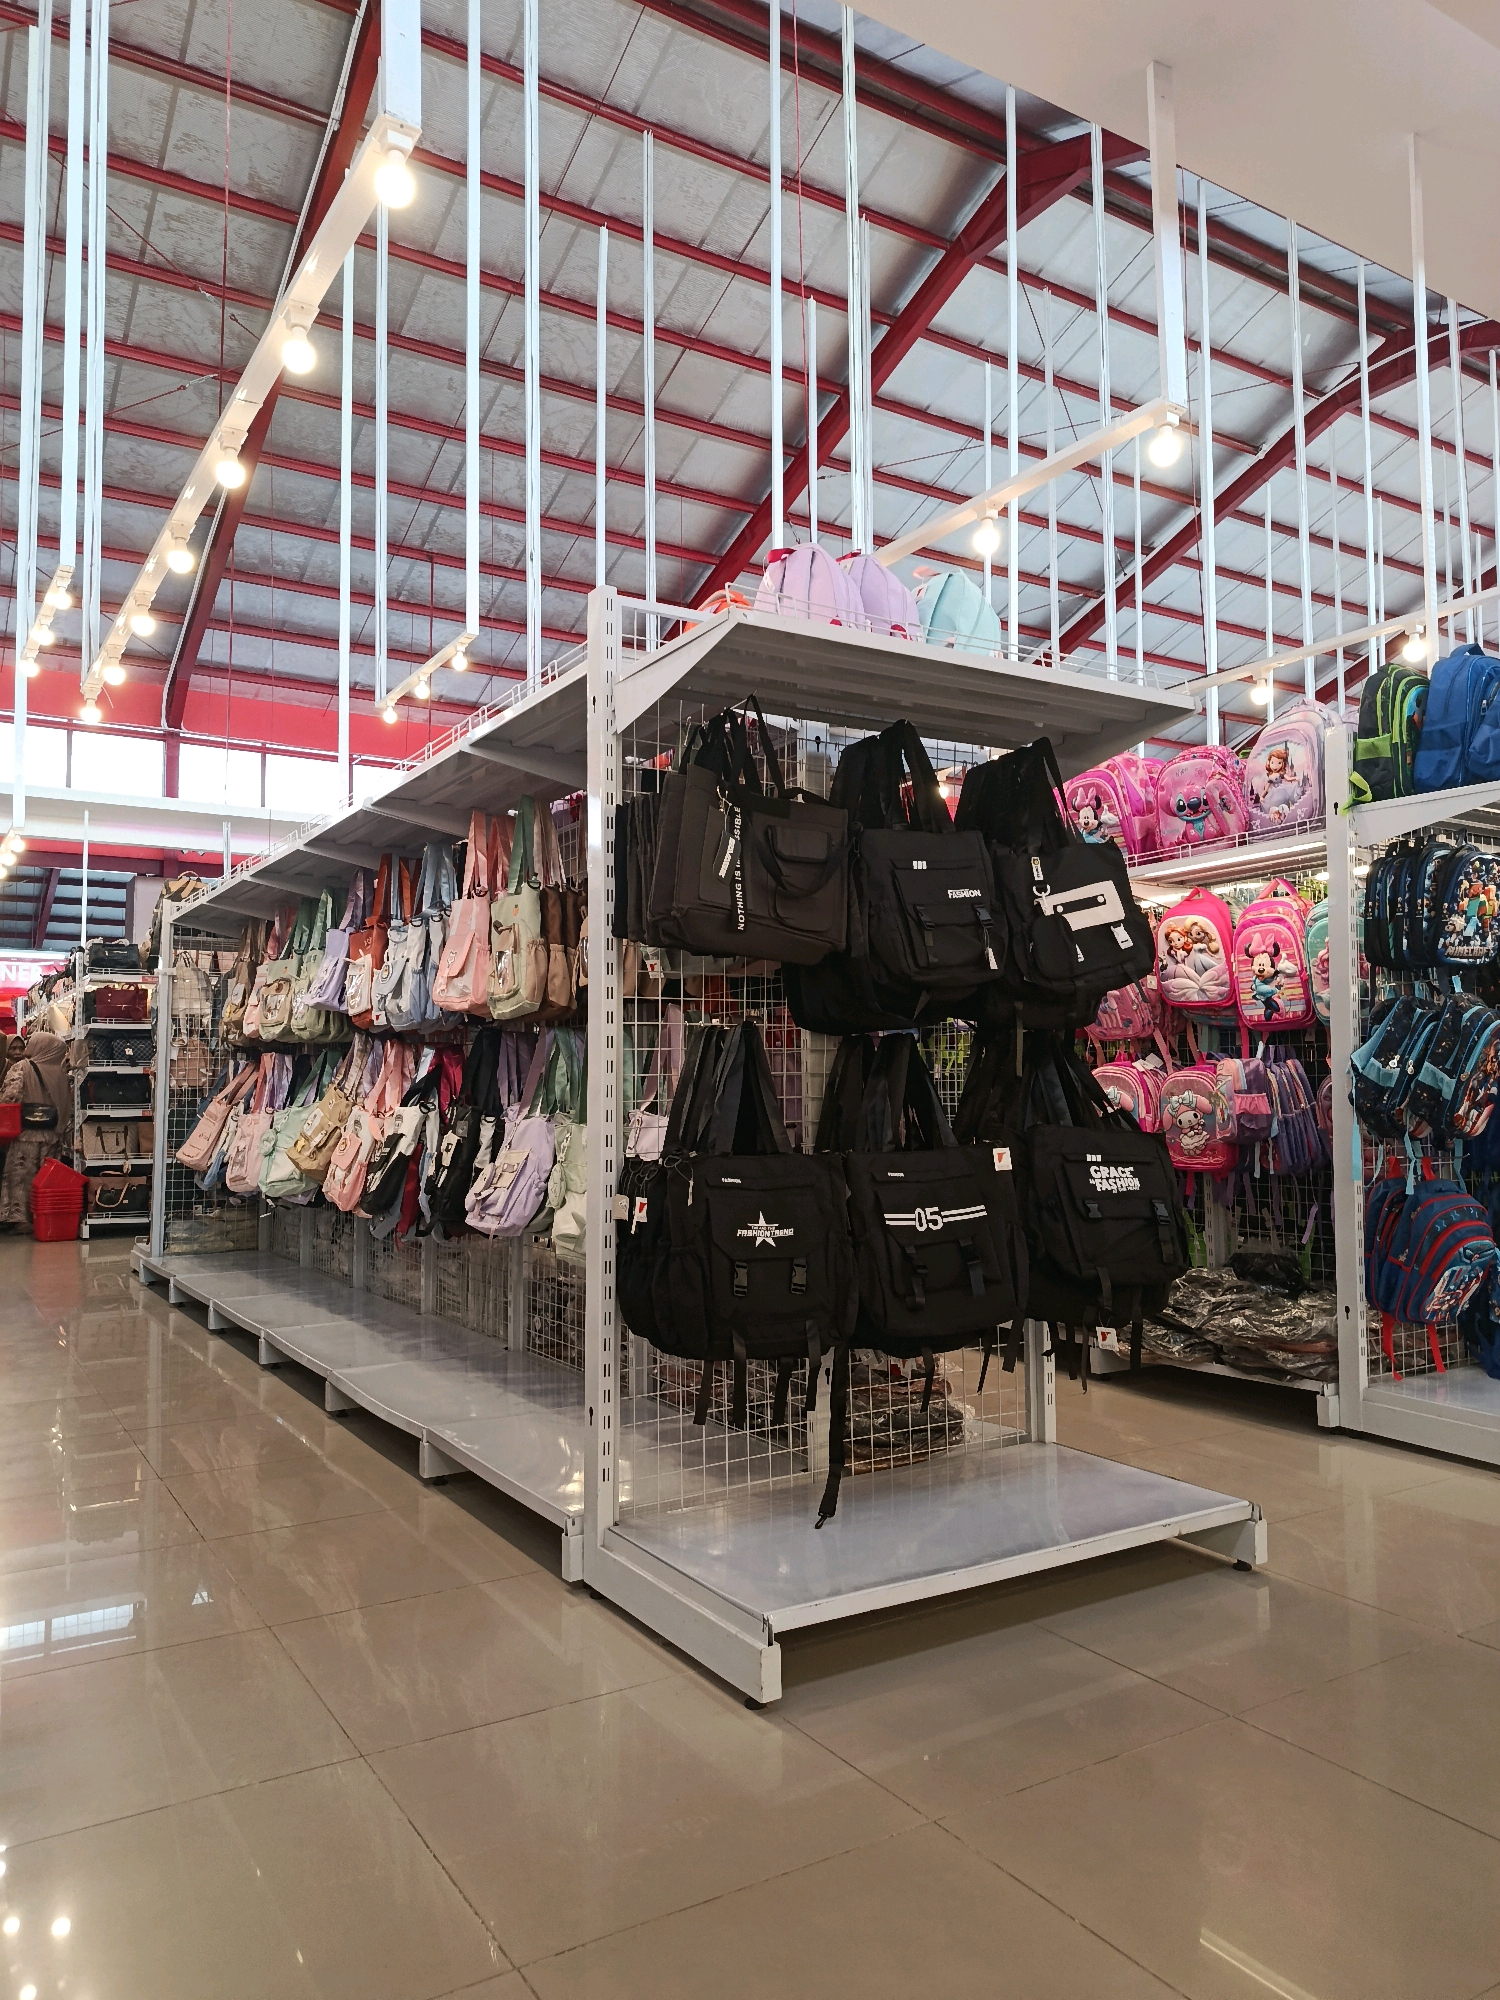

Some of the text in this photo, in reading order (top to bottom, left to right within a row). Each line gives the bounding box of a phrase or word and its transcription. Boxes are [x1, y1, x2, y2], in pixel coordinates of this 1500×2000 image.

[735, 870, 742, 881] IS
[947, 888, 982, 899] FASHION
[735, 883, 745, 931] NOTHING
[1444, 945, 1493, 957] MINECRAFT
[1089, 1165, 1135, 1178] GRACE
[914, 1206, 944, 1232] 05
